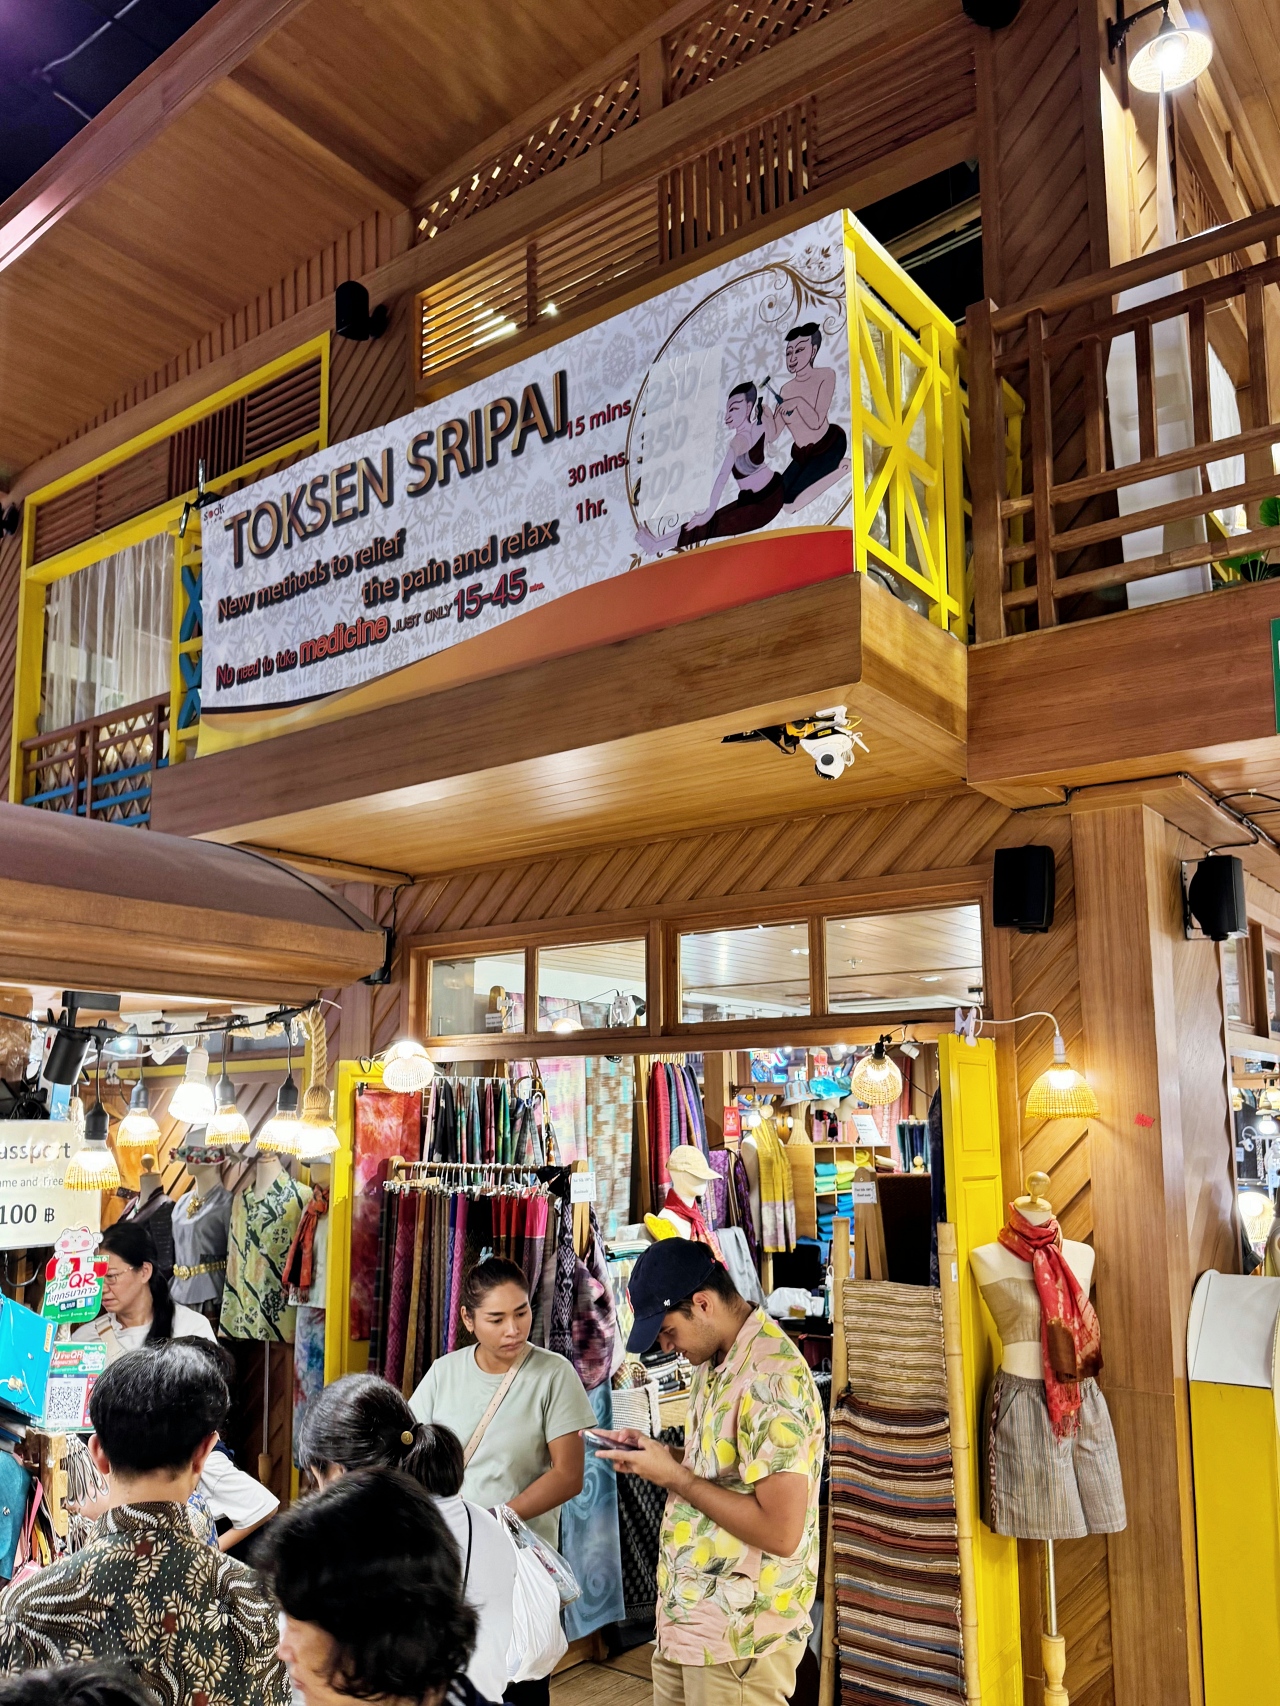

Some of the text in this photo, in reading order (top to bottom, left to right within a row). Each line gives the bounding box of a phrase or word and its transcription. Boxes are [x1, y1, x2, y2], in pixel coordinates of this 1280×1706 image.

[567, 399, 632, 440] 15 mins
[224, 369, 568, 569] TOKSEN SRIPAI
[568, 451, 630, 488] 30 mins.
[217, 528, 406, 624] New methods to relief
[362, 519, 560, 609] the pain and relax
[216, 663, 235, 692] No
[236, 656, 261, 685] need
[262, 655, 274, 675] to
[275, 648, 298, 674] take
[298, 615, 391, 670] medicine
[392, 613, 422, 633] JUST
[423, 602, 455, 624] ONLY
[453, 567, 527, 623] 15-45
[20, 1177, 38, 1187] and
[0, 1203, 37, 1225] 100
[69, 1273, 96, 1288] QR
